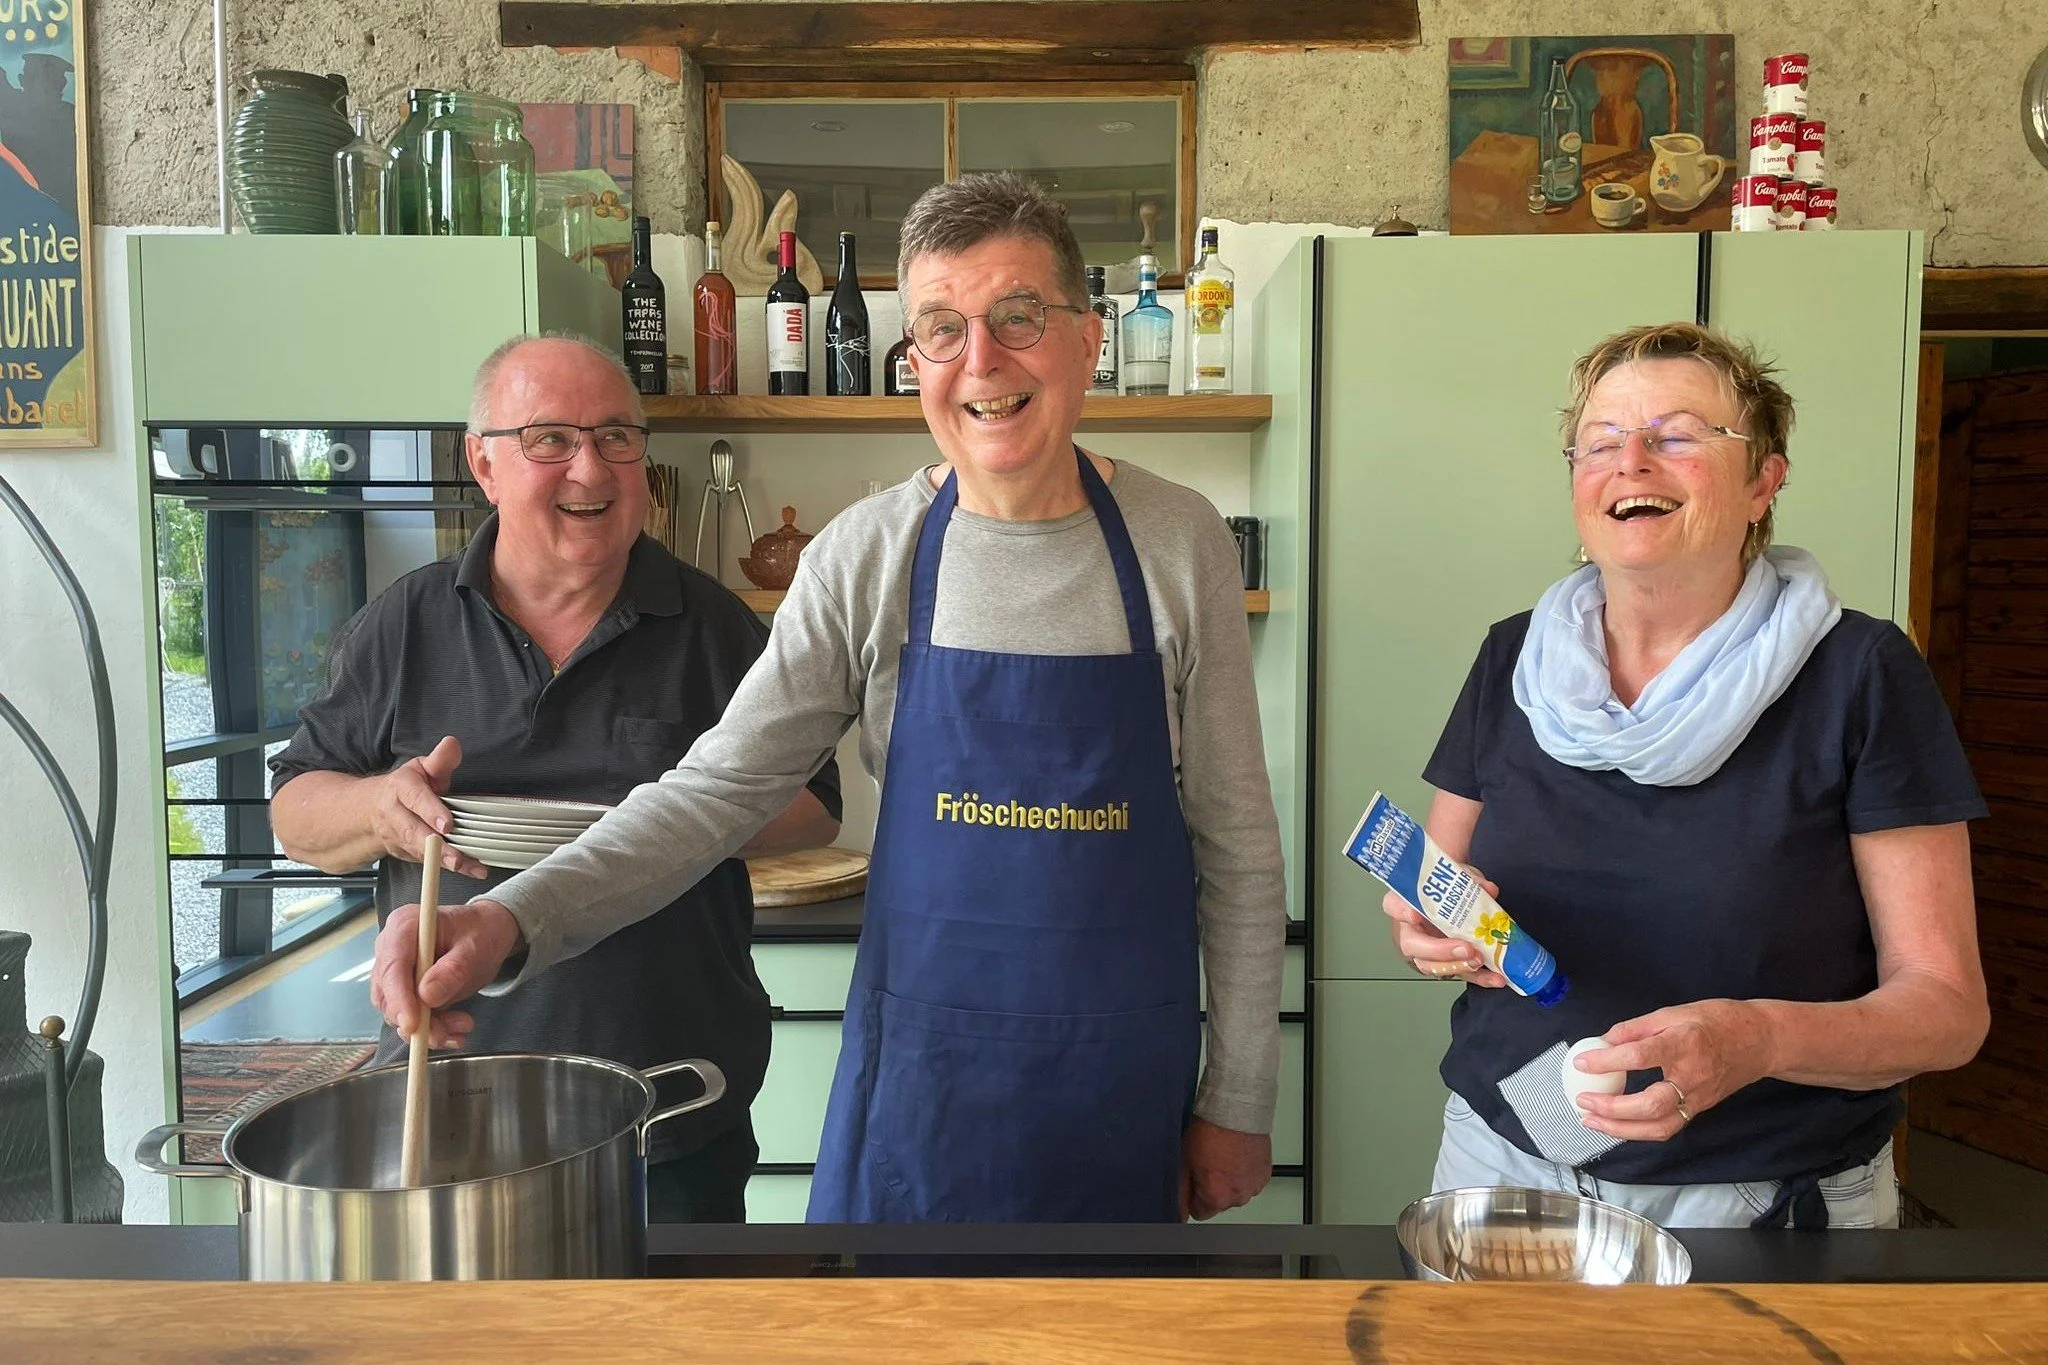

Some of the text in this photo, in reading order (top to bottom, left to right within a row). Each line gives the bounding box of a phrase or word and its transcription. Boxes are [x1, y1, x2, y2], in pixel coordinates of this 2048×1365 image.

[0, 278, 76, 349] UANT
[627, 308, 662, 319] TAPAS
[632, 297, 657, 308] THE
[624, 330, 665, 342] COLLECTIO
[629, 319, 662, 331] WINE
[0, 386, 85, 425] baret
[936, 792, 1129, 831] Fröschechuchi
[1422, 856, 1457, 903] SENF
